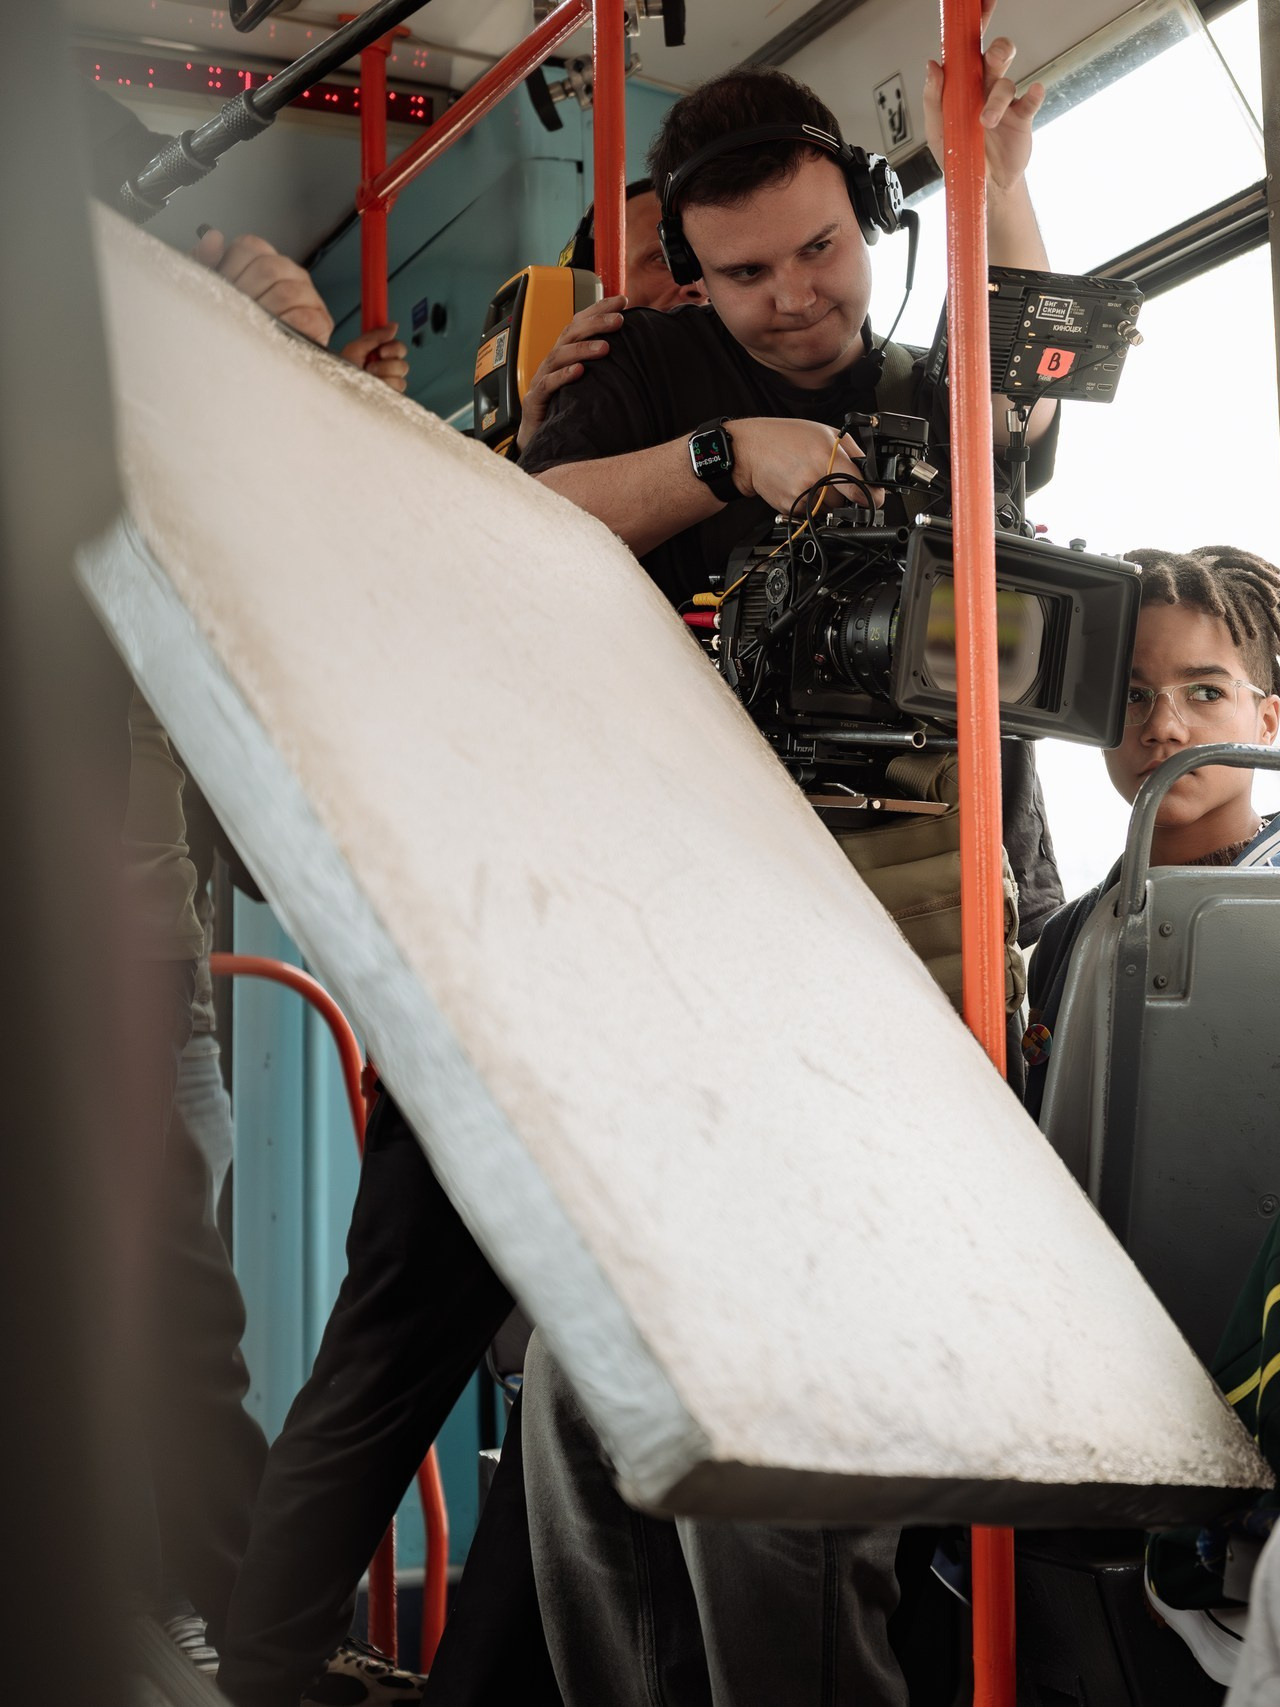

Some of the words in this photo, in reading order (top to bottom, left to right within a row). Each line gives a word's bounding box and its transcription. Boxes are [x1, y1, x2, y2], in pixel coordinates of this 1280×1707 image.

[1042, 307, 1066, 315] СКРИН
[1052, 324, 1083, 333] КИНОЦЕХ
[869, 627, 881, 642] 25
